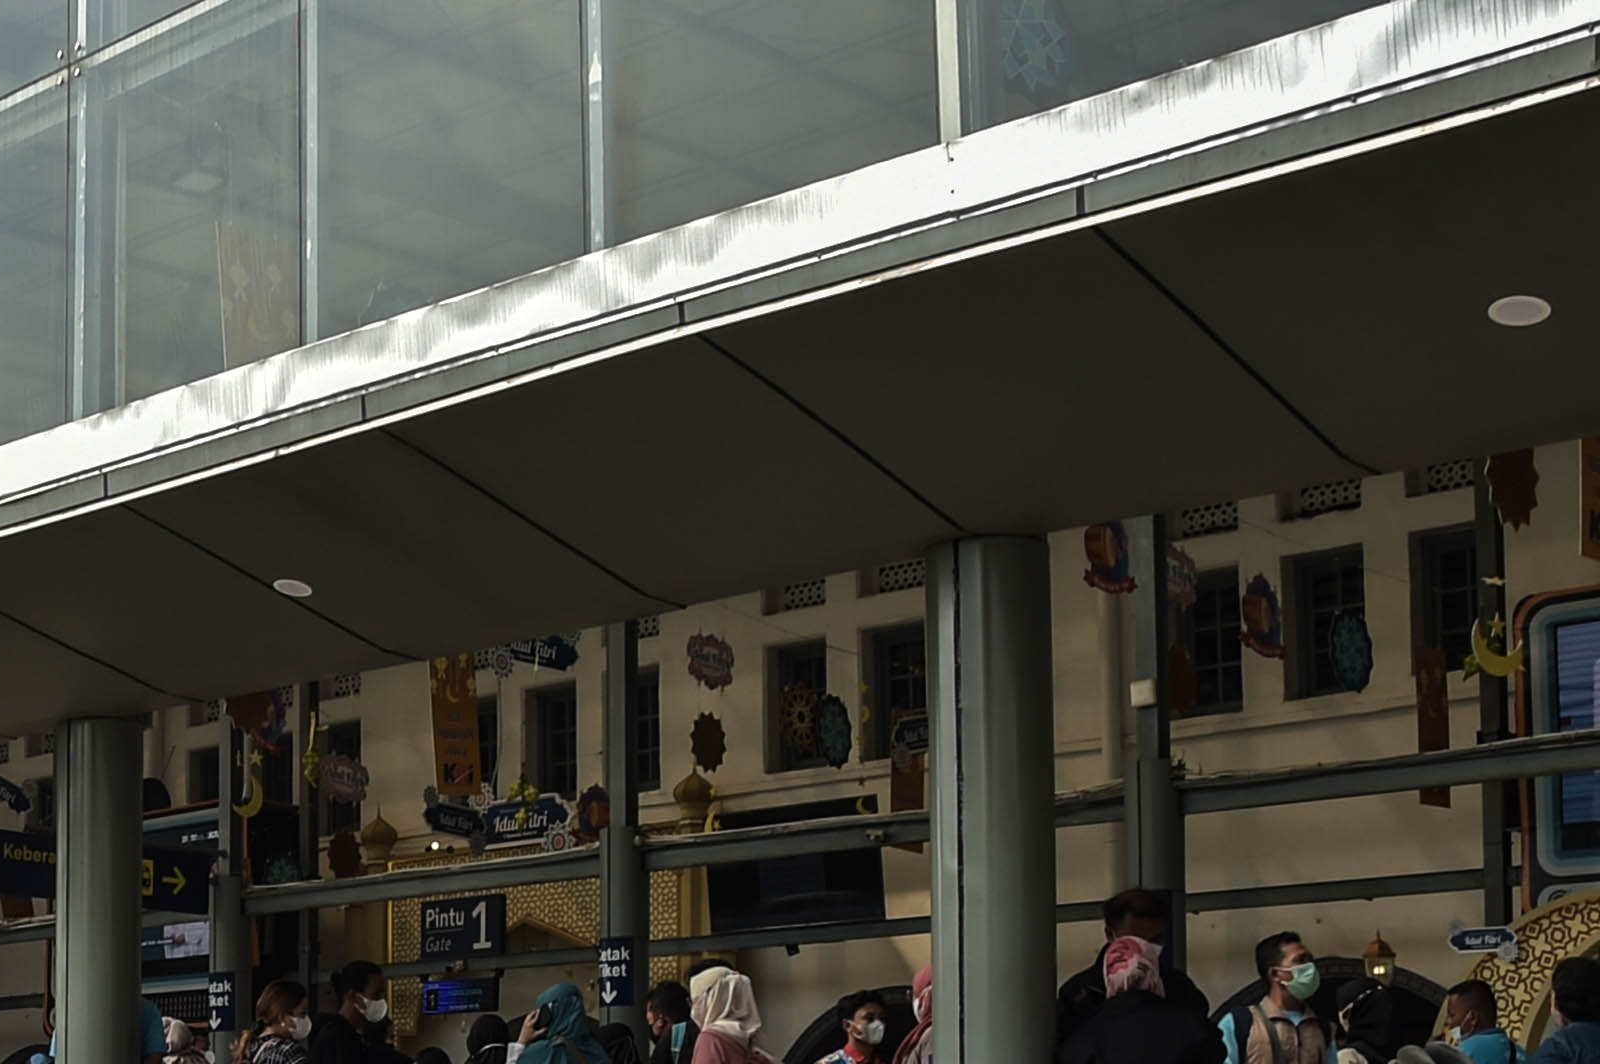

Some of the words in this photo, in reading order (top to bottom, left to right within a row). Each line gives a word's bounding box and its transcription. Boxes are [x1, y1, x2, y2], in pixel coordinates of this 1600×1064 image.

[425, 907, 465, 929] Pintu
[471, 900, 493, 951] 1
[425, 936, 452, 953] Gate
